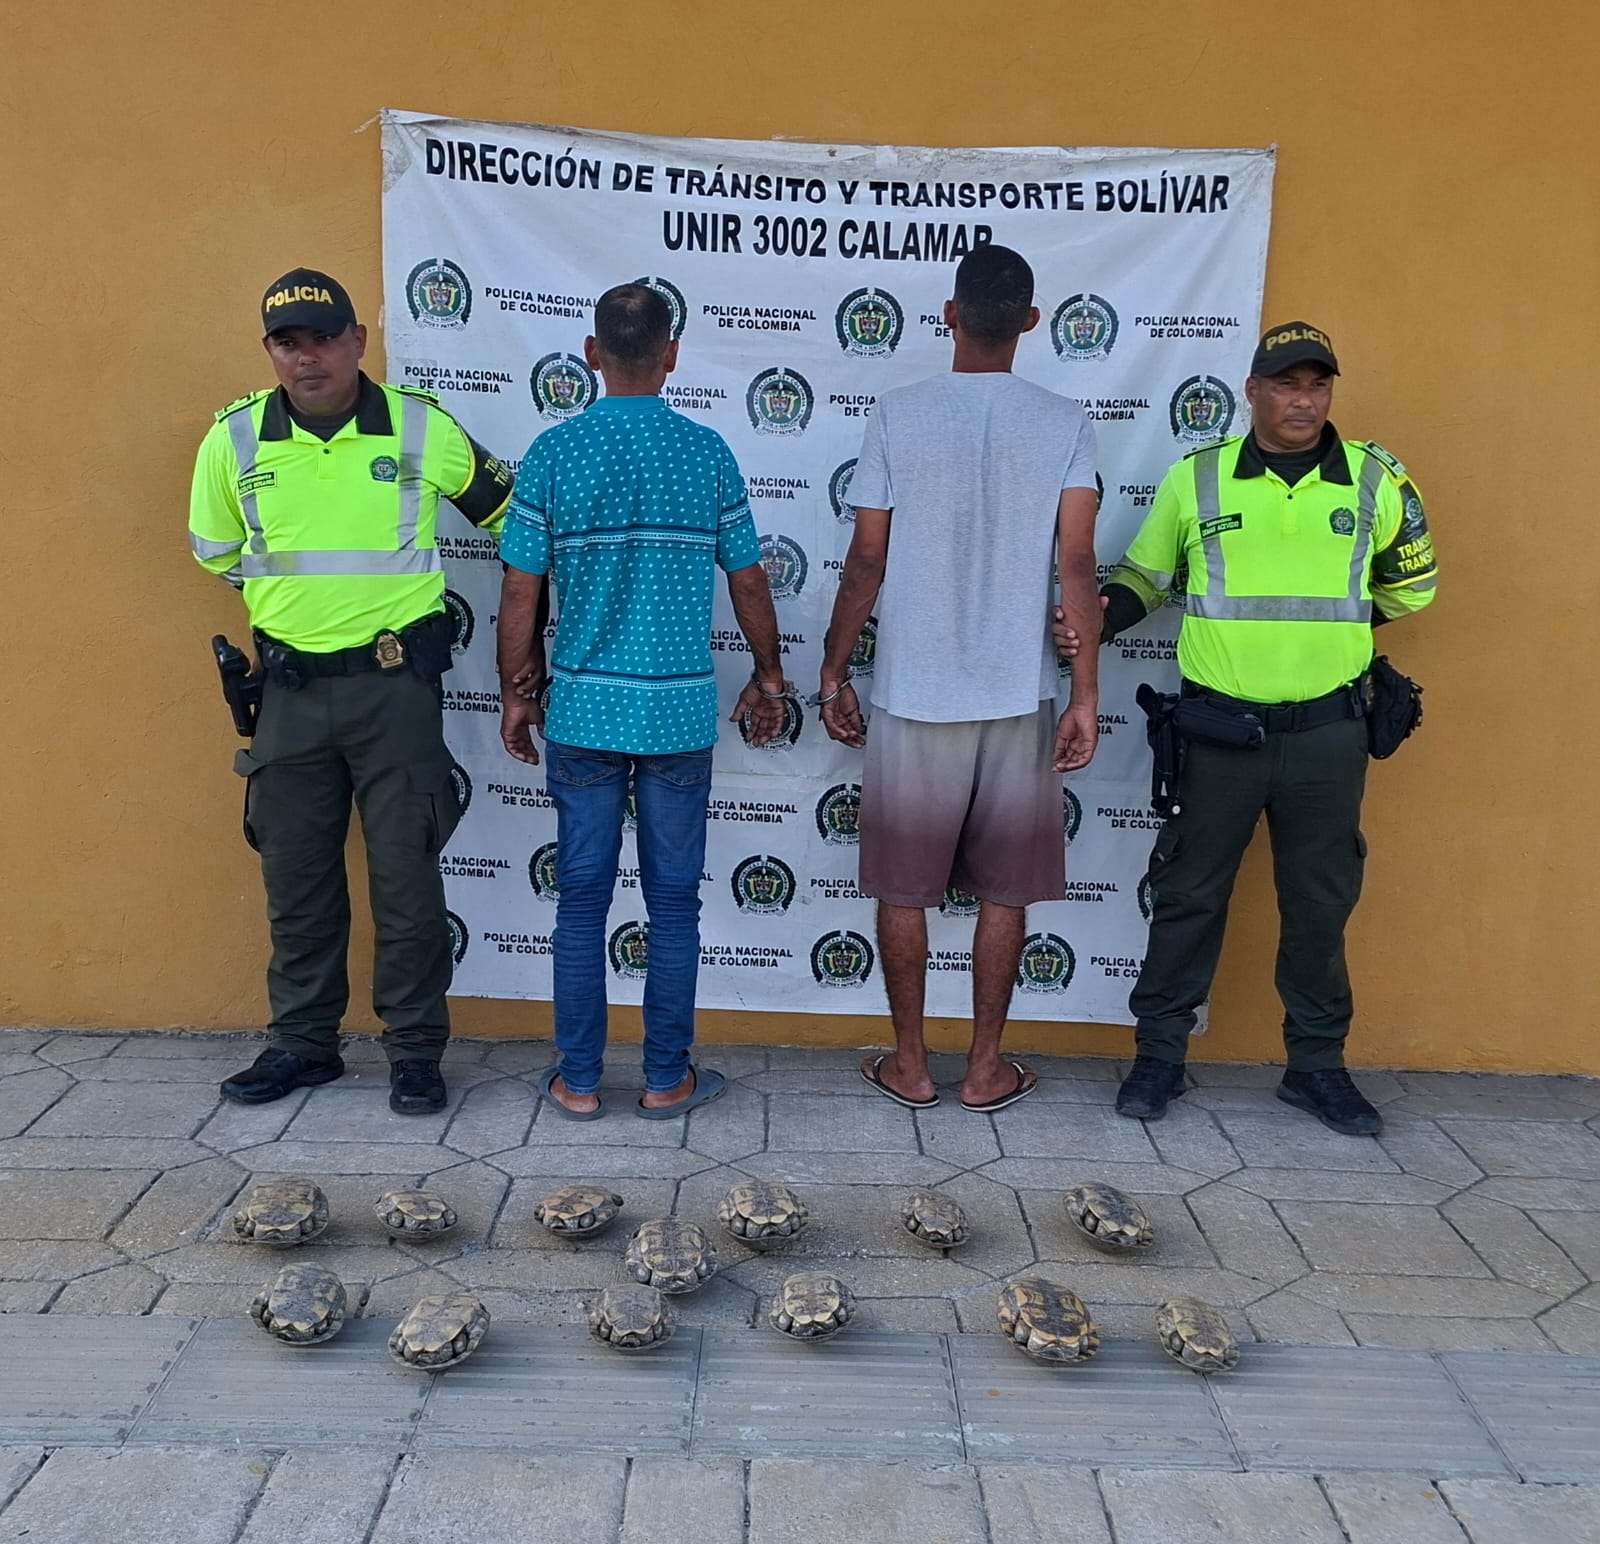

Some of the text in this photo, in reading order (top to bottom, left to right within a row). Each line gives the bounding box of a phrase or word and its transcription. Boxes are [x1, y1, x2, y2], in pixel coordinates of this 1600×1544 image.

[425, 138, 1230, 214] DIRECCIÓN DE TRÁNSITO Y TRANSPORTE BOLÍVAR
[663, 211, 742, 254] UNIR
[753, 215, 827, 258] 3002
[266, 286, 334, 312] POLICIA
[485, 287, 599, 308] POLICIA NACIONAL
[500, 300, 584, 319] DE COLOMBIA
[703, 305, 816, 320] POLICIA NACIONAL
[718, 318, 801, 331] DE COLOMBIA
[1135, 316, 1240, 327] POLICIA NACIONAL
[934, 328, 950, 337] DE
[1150, 328, 1224, 338] DE COLOMBIA
[405, 366, 513, 383] POLICIA NACIONAL
[419, 380, 501, 393] DE COLOMBIA
[666, 387, 727, 399] NACIONAL
[662, 397, 712, 410] LOMBIA
[830, 394, 876, 405] POLICIA
[1096, 399, 1150, 409] NACIONAL
[845, 407, 860, 417] DE
[1087, 410, 1135, 420] OLOMBIA
[750, 477, 810, 488] NACIONAL
[746, 488, 795, 499] LOMBIA
[1119, 485, 1156, 495] POLICI
[1133, 497, 1148, 506] DE
[455, 538, 500, 549] NACION
[440, 549, 500, 560] COLOMBIA
[711, 631, 741, 641] LICIA
[711, 641, 790, 653] DE COLIA
[1108, 639, 1153, 648] POLICIA
[1122, 650, 1177, 660] DE COLO
[457, 691, 500, 702] NACION
[441, 701, 500, 713] COLOMBIA
[488, 784, 532, 796] POLICIA
[502, 796, 556, 809] DE COLO
[707, 800, 798, 813] LICIA NACIONAL
[706, 811, 783, 823] DE COLOMBIA
[1097, 808, 1143, 818] POLICIA
[1111, 819, 1161, 830] DE COLO
[452, 856, 511, 869] NACIONAL
[440, 867, 496, 878] COLOMBIA
[616, 868, 640, 877] OLIC
[621, 879, 637, 888] DE
[810, 879, 856, 888] POLICIA
[1066, 882, 1118, 892] ACIONAL
[825, 889, 841, 898] DE
[1067, 892, 1104, 902] OMBIA
[484, 932, 528, 943] POLICIA
[498, 944, 553, 955] DE COLO
[702, 946, 793, 957] LICIA NACIONAL
[701, 956, 778, 967] DE COLOMBIA
[936, 951, 972, 961] NACIO
[928, 962, 972, 971] OLOMBI
[1090, 957, 1138, 968] POLICIA
[1105, 968, 1119, 977] DE
